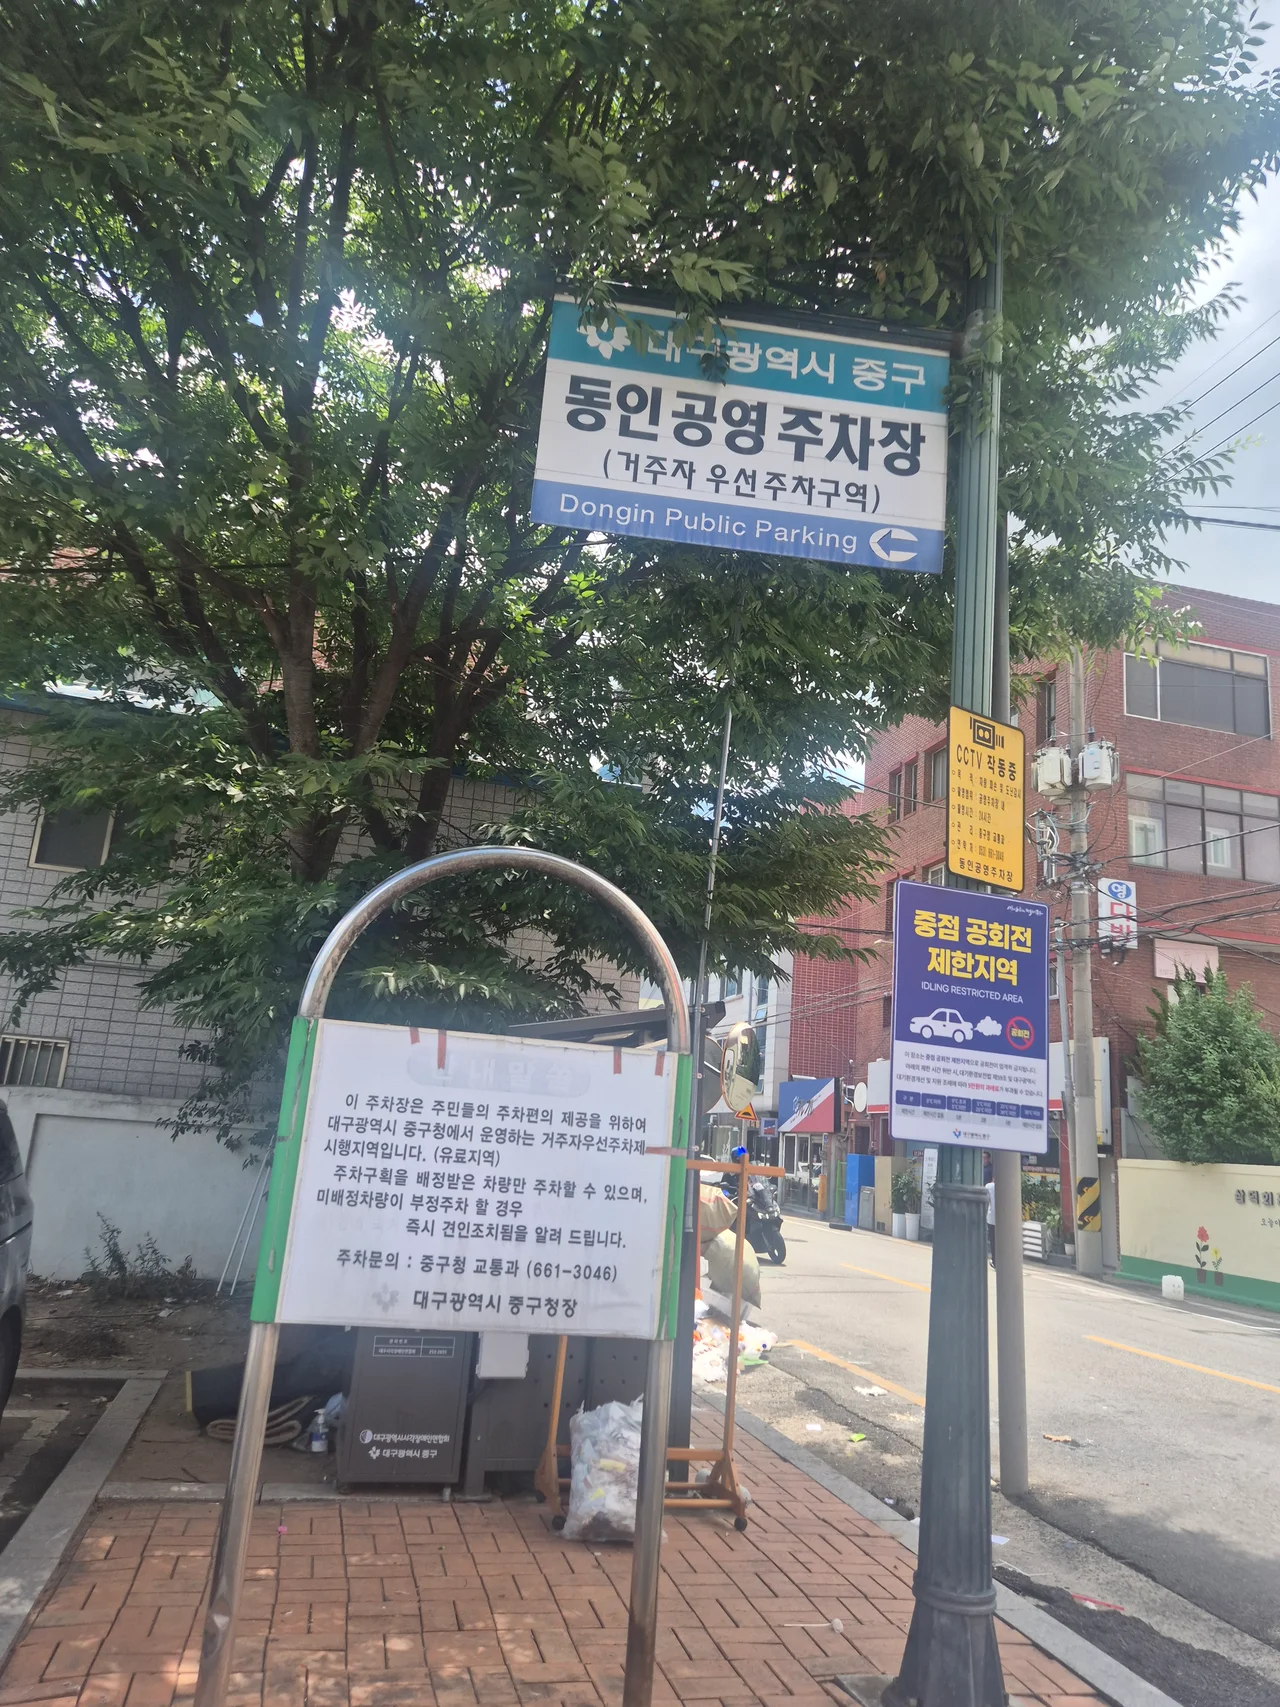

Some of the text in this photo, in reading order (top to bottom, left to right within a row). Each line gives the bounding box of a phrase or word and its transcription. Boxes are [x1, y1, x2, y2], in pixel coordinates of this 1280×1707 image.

[852, 357, 926, 394] 중구
[565, 374, 926, 476] 동인공영주차장
[603, 449, 880, 513] (거주자 우선주차구역)
[560, 494, 856, 553] Dongin Public Parking
[956, 744, 1017, 782] CCTV 작동중
[959, 858, 1013, 882] 동인공영주차장
[914, 909, 1032, 953] 중점 공회전
[927, 946, 1018, 986] 제한지역
[921, 981, 1024, 1004] IDLING RESTRICTED AREA
[345, 1094, 647, 1133] 이 주차장은 주민들의 주차편의 제공을 위하여
[324, 1138, 501, 1168] 시행지역입니다. (유료지역)
[328, 1116, 647, 1156] 대구광역시 중구청에서 운영하는 거주자우선주차제
[316, 1188, 523, 1218] 미배정차량이 부정주차 할 경우
[333, 1165, 648, 1205] 주차구획을 배정받은 차량만 주차할 수 있으며,
[405, 1219, 627, 1250] 즉시 견인조치됨을 알려 드립니다.
[336, 1249, 399, 1270] 주차문의
[420, 1255, 466, 1275] 중구청
[473, 1258, 519, 1278] 교통과
[526, 1262, 617, 1283] (661-3046)
[413, 1290, 578, 1318] 대구광역시 중구청장
[382, 1449, 421, 1459] 대구광역시
